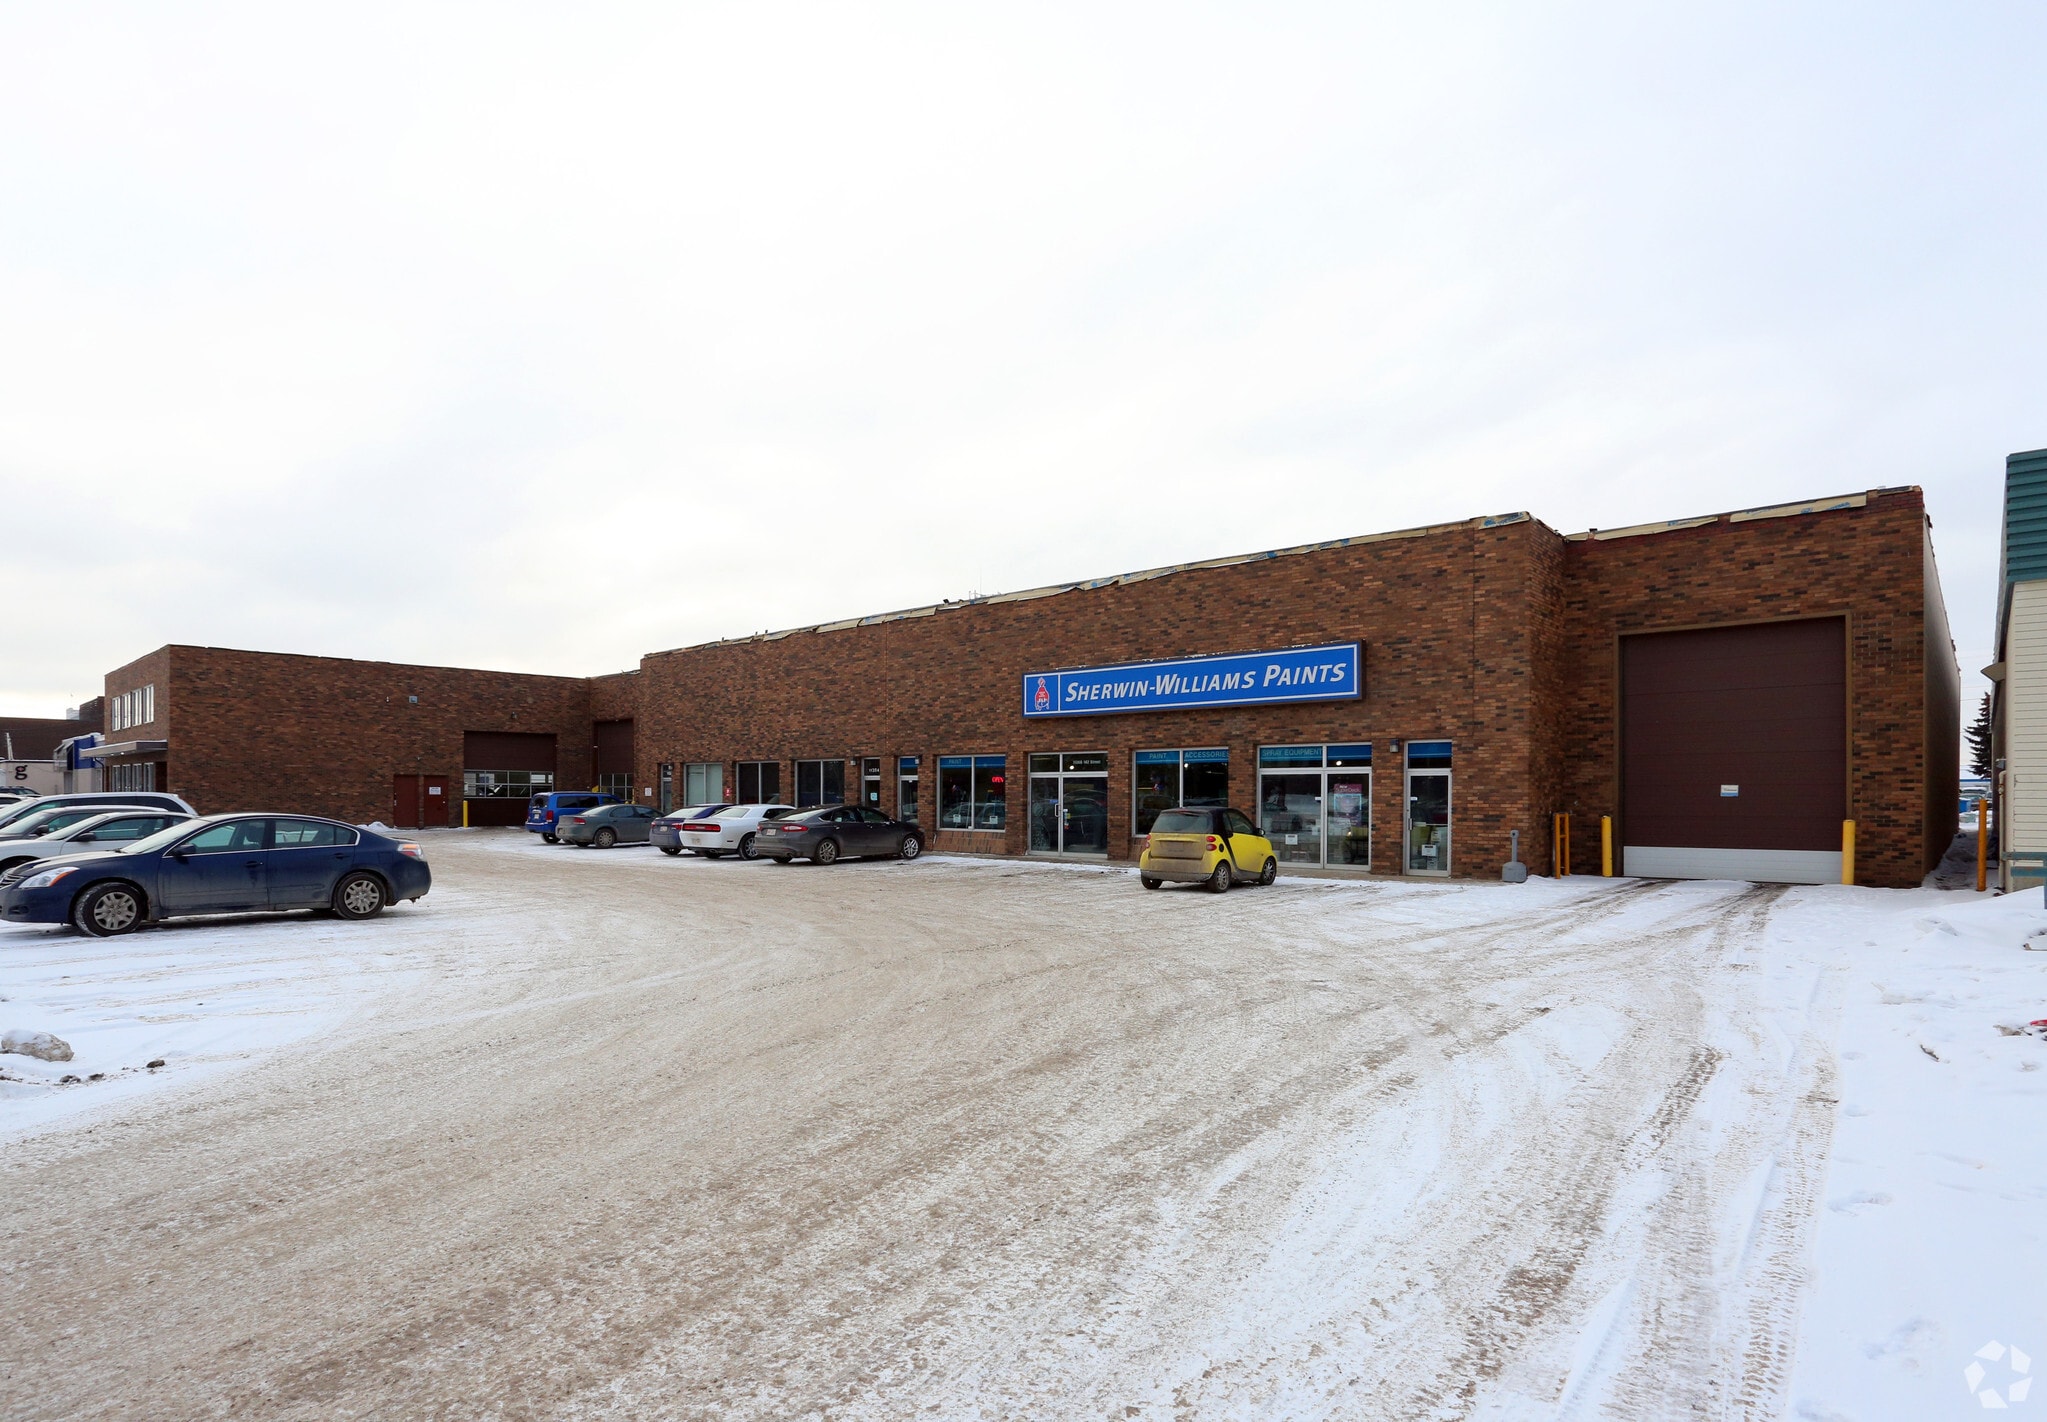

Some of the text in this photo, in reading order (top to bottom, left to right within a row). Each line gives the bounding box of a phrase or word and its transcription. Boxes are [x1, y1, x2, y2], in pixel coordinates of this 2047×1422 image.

[1065, 671, 1257, 702] SHERWIN-WILLIAMS
[1262, 662, 1347, 688] PAINTS
[1149, 752, 1168, 760] PAINT
[1262, 749, 1282, 757] SPRAY
[15, 764, 28, 781] g
